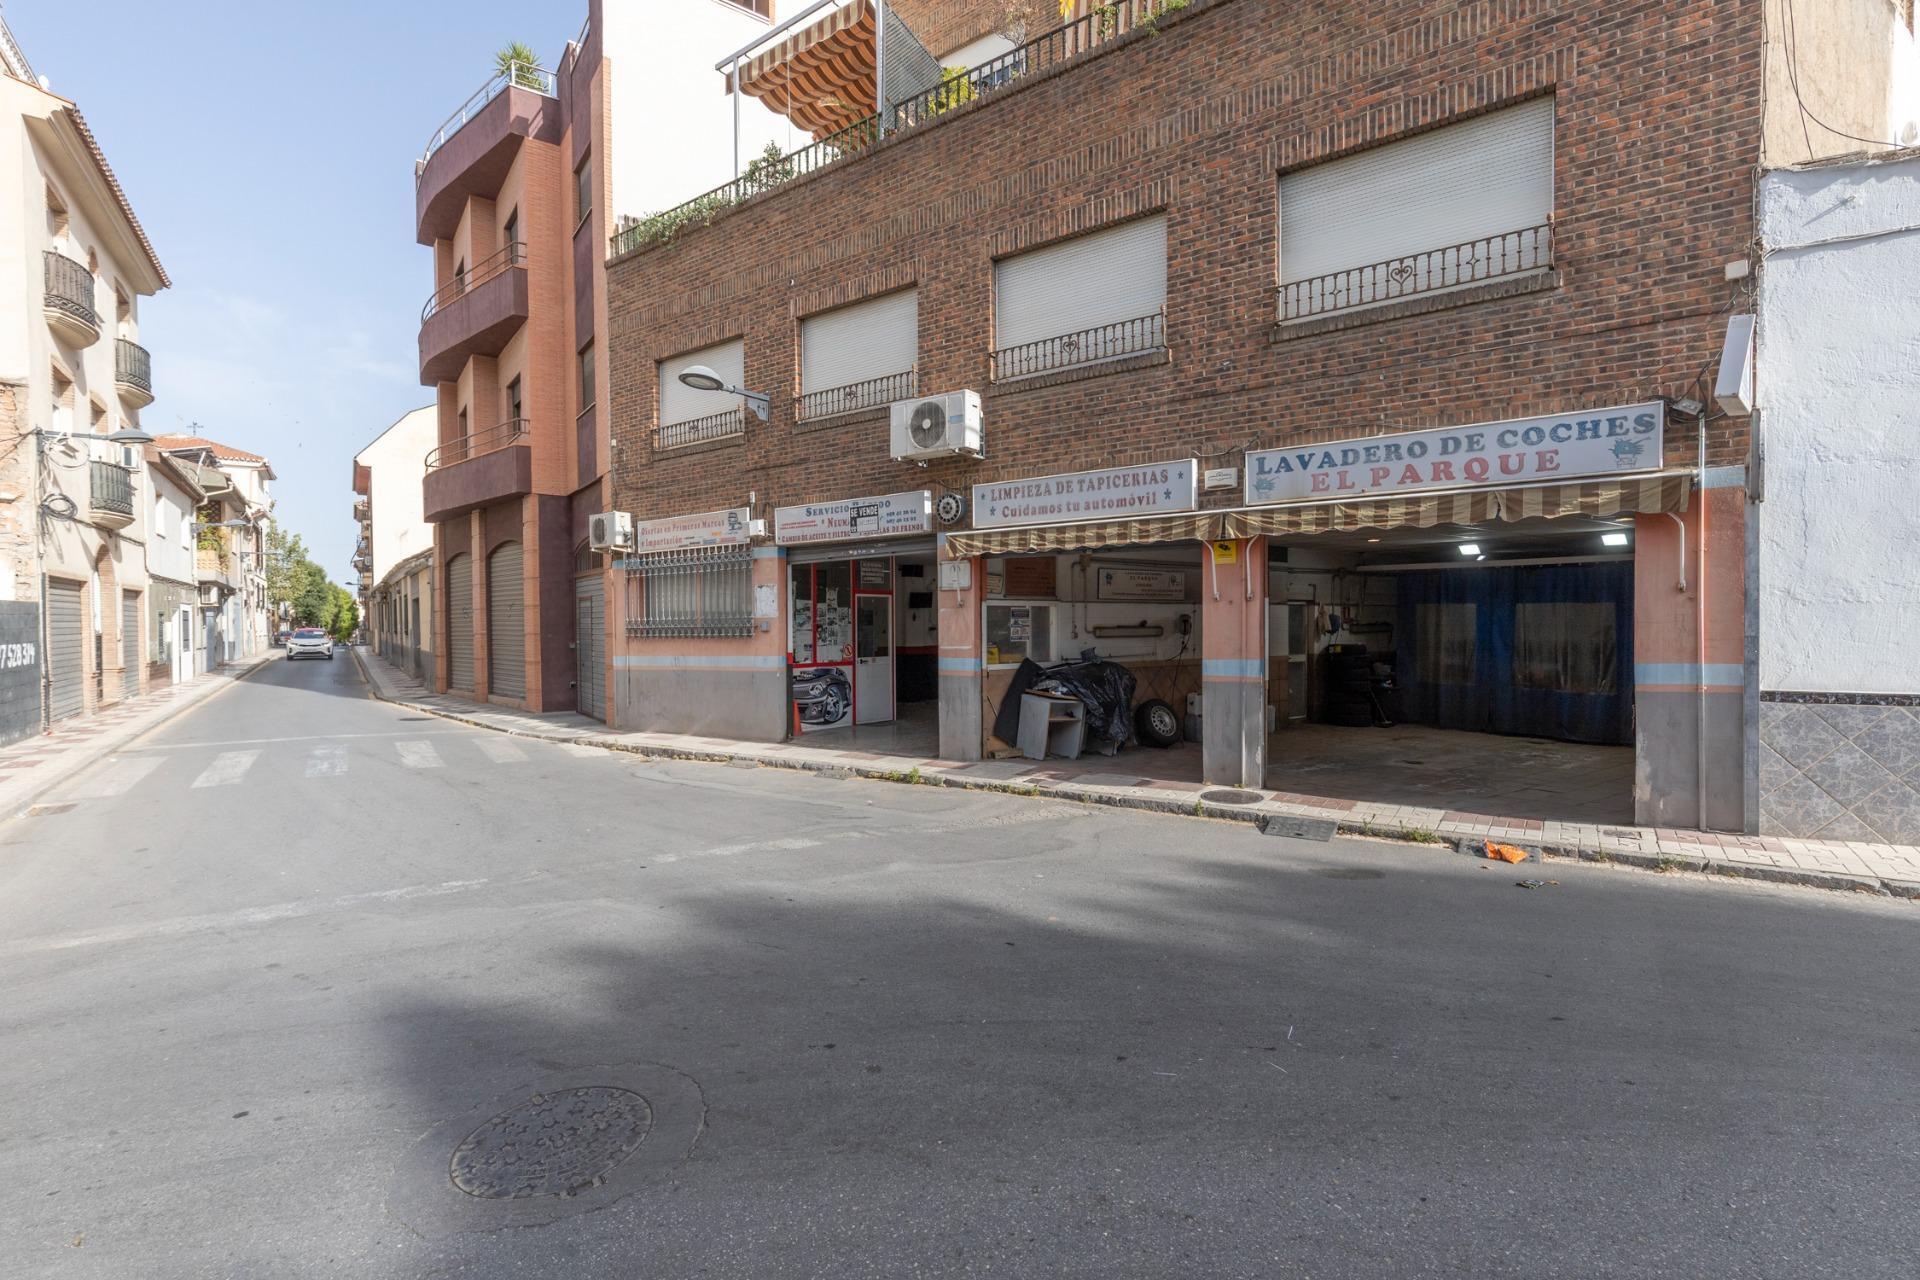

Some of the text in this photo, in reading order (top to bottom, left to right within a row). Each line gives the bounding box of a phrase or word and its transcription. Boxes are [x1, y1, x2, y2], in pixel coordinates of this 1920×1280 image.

[1256, 413, 1657, 475] LAVADERO DE COCHES
[1310, 449, 1562, 493] EL PARQUE
[990, 469, 1169, 502] LIMPIEZA DE TAPICERIAS
[850, 505, 878, 518] SE VENDE
[1002, 491, 1157, 519] Cuidamos tu automóvil
[672, 522, 701, 532] Primeras
[702, 520, 725, 529] Marcas
[0, 644, 7, 669] 7
[7, 643, 22, 668] 528
